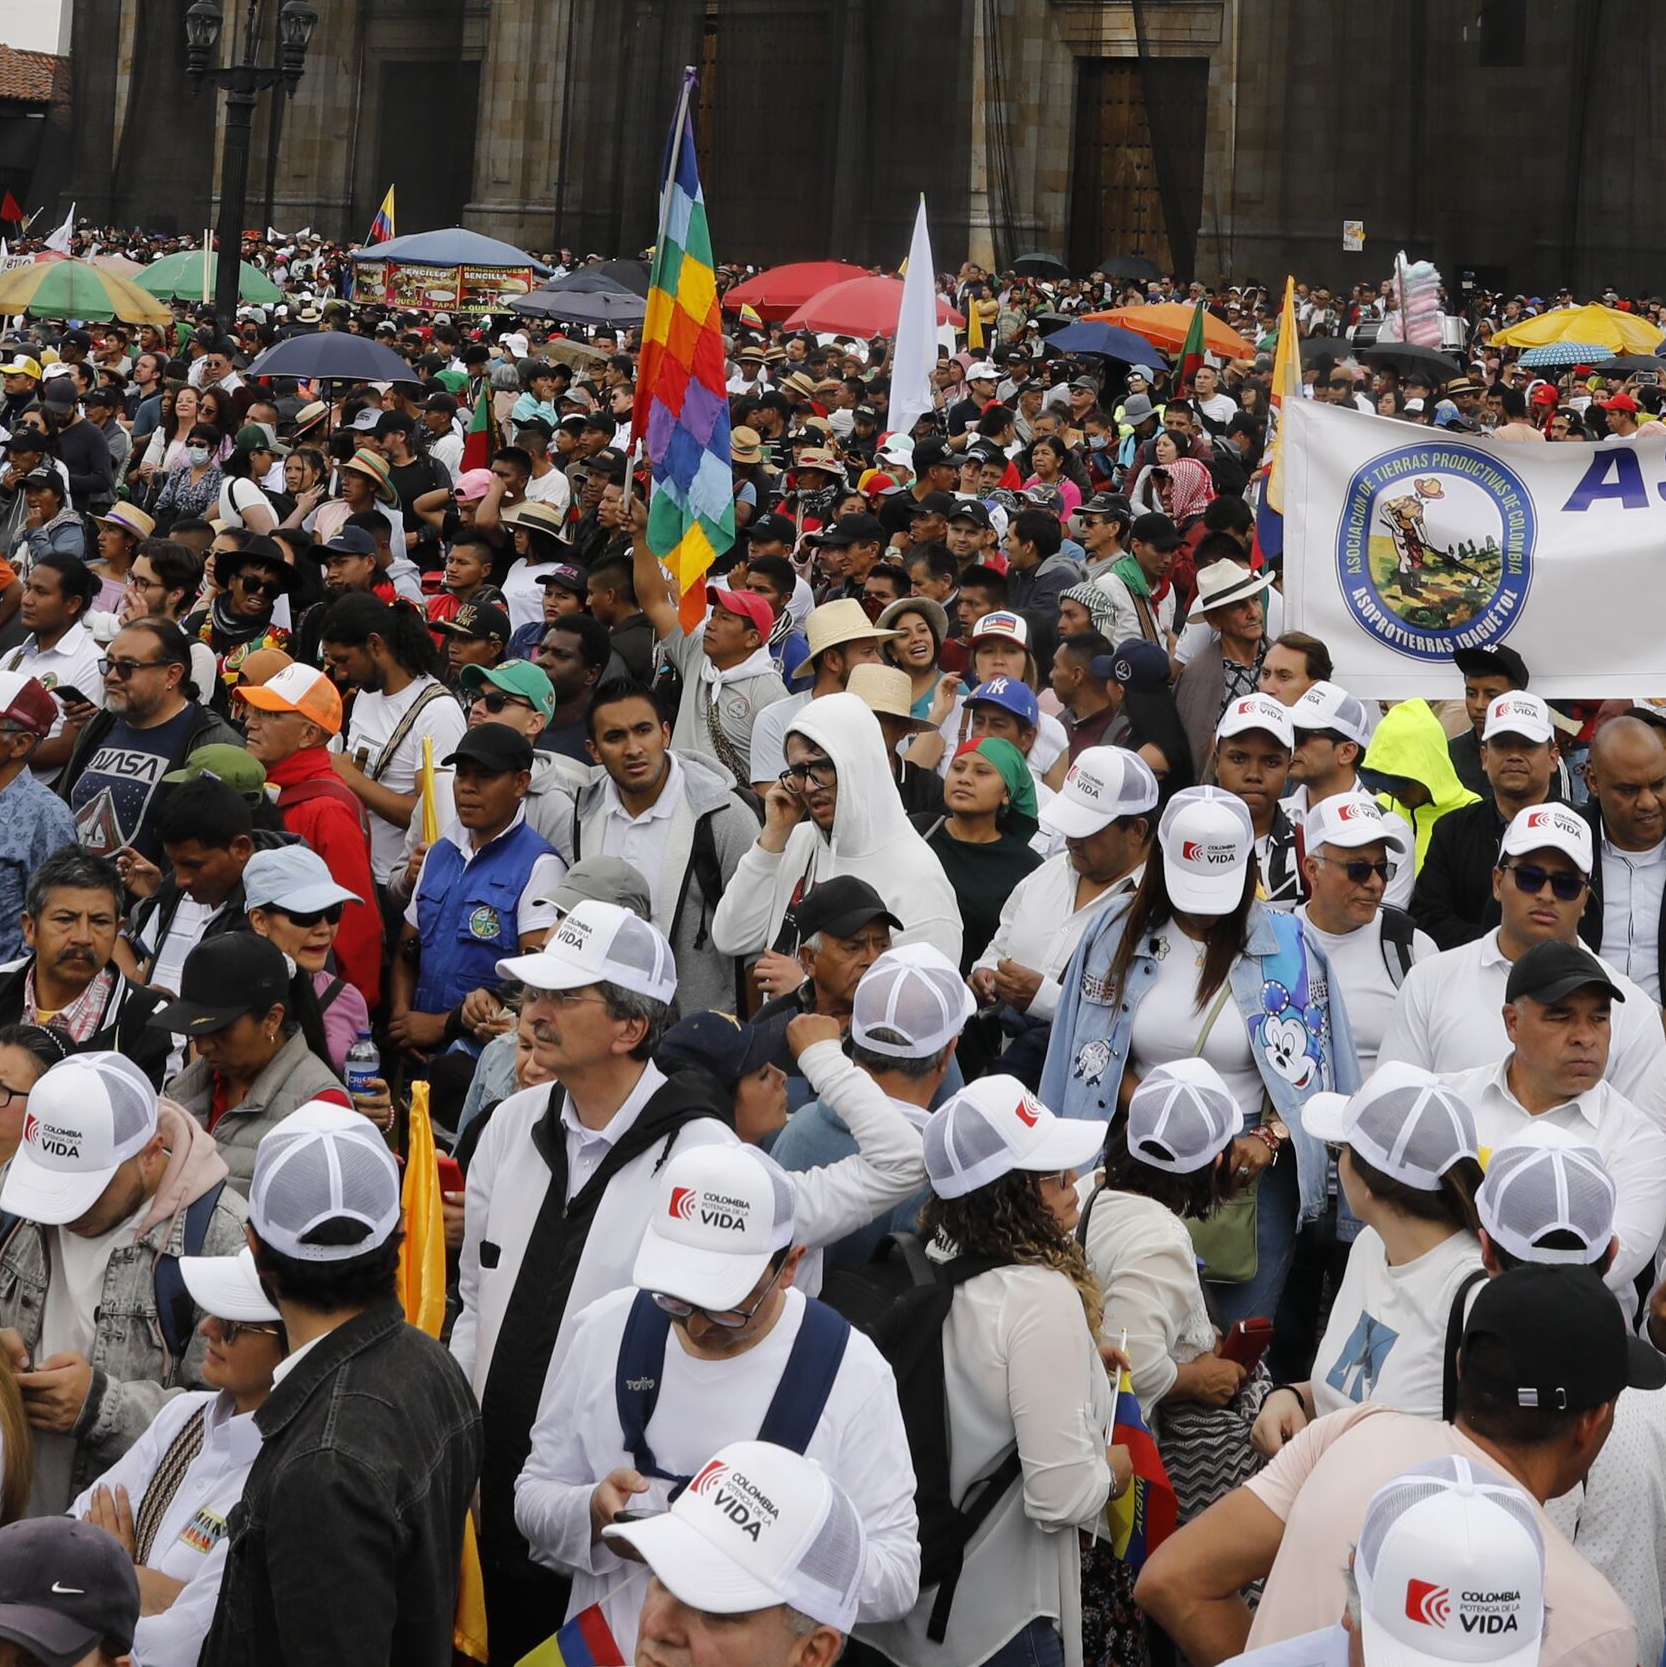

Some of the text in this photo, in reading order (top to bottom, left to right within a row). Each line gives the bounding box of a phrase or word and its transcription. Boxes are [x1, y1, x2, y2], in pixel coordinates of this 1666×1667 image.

[464, 272, 508, 281] SENCILLA
[1372, 453, 1429, 483] TIERRAS
[1432, 452, 1511, 496] PRODUCTIVAS
[1358, 478, 1376, 496] DE
[1502, 493, 1521, 510] DE
[1508, 508, 1526, 574] COLOMBIA
[1352, 586, 1455, 653] ASOPROTIERRAS
[1260, 708, 1283, 723] VIDA
[1513, 707, 1538, 719] VIDA
[93, 749, 157, 781] NASA
[1077, 779, 1099, 799] VIDA
[1554, 820, 1581, 840] VIDA
[1207, 854, 1235, 864] VIDA
[557, 929, 583, 951] VIDA
[43, 1123, 83, 1139] COLOMBIA
[41, 1138, 80, 1158] VIDA
[702, 1202, 731, 1213] POTENCIA
[704, 1192, 750, 1209] COLOMBIA
[701, 1209, 745, 1232] VIDA
[724, 1482, 754, 1510] POTENCIA
[731, 1473, 779, 1520] COLOMBIA
[713, 1489, 761, 1542] VIDA
[1461, 1590, 1521, 1603] COLOMBIA
[1459, 1602, 1500, 1614] POTENCIA
[1459, 1613, 1518, 1634] VIDA
